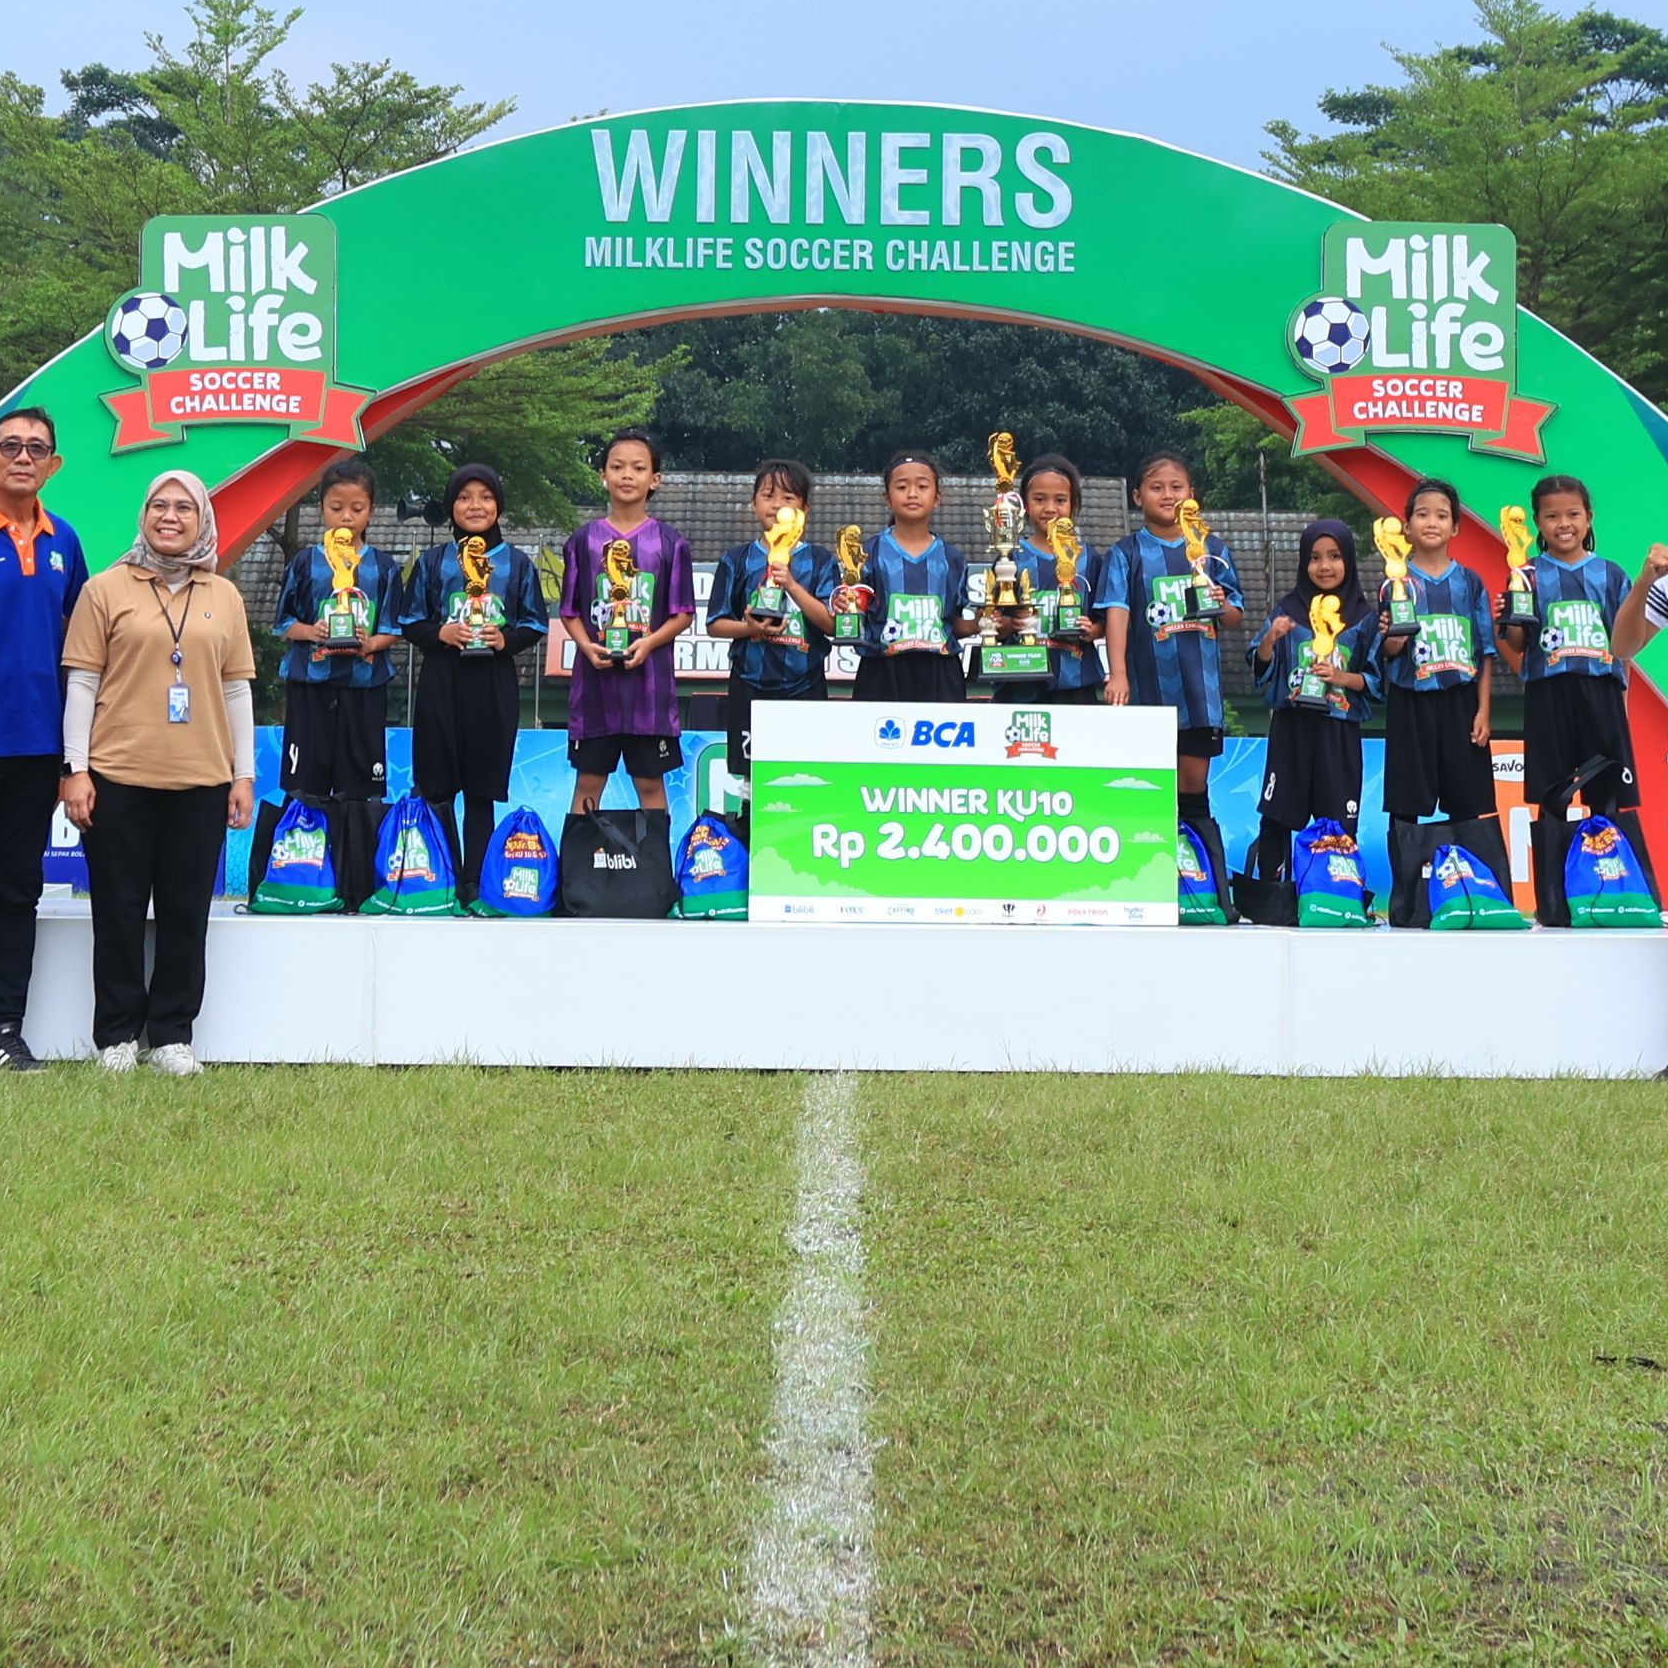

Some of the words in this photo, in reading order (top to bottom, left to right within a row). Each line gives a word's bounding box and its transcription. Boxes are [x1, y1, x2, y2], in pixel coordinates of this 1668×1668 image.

[590, 128, 1073, 229] WINNERS
[163, 225, 318, 295] Milk
[583, 236, 733, 270] MILKLIFE
[744, 238, 874, 272] SOCCER
[885, 240, 1076, 274] CHALLENGE
[1345, 233, 1500, 305] Milk
[188, 294, 323, 362] Life
[1370, 302, 1505, 372] Life
[189, 371, 281, 392] SOCCER
[1371, 378, 1463, 399] SOCCER
[169, 393, 302, 415] CHALLENGE
[1352, 401, 1484, 423] CHALLENGE
[894, 598, 940, 622] Milk
[1553, 604, 1603, 626] Milk
[902, 619, 941, 644] Life
[1421, 617, 1466, 643] Milk
[1563, 625, 1606, 648] Life
[1431, 640, 1469, 664] Life
[1015, 712, 1048, 729] Milk
[910, 720, 975, 748] BCA
[1019, 727, 1049, 742] Life
[1492, 758, 1525, 773] SAVO
[1264, 772, 1276, 802] 8
[860, 786, 989, 815] WINNER
[996, 789, 1073, 823] KU10
[812, 823, 865, 869] Rp
[876, 821, 1121, 864] 2.400.000
[606, 852, 637, 870] blibl
